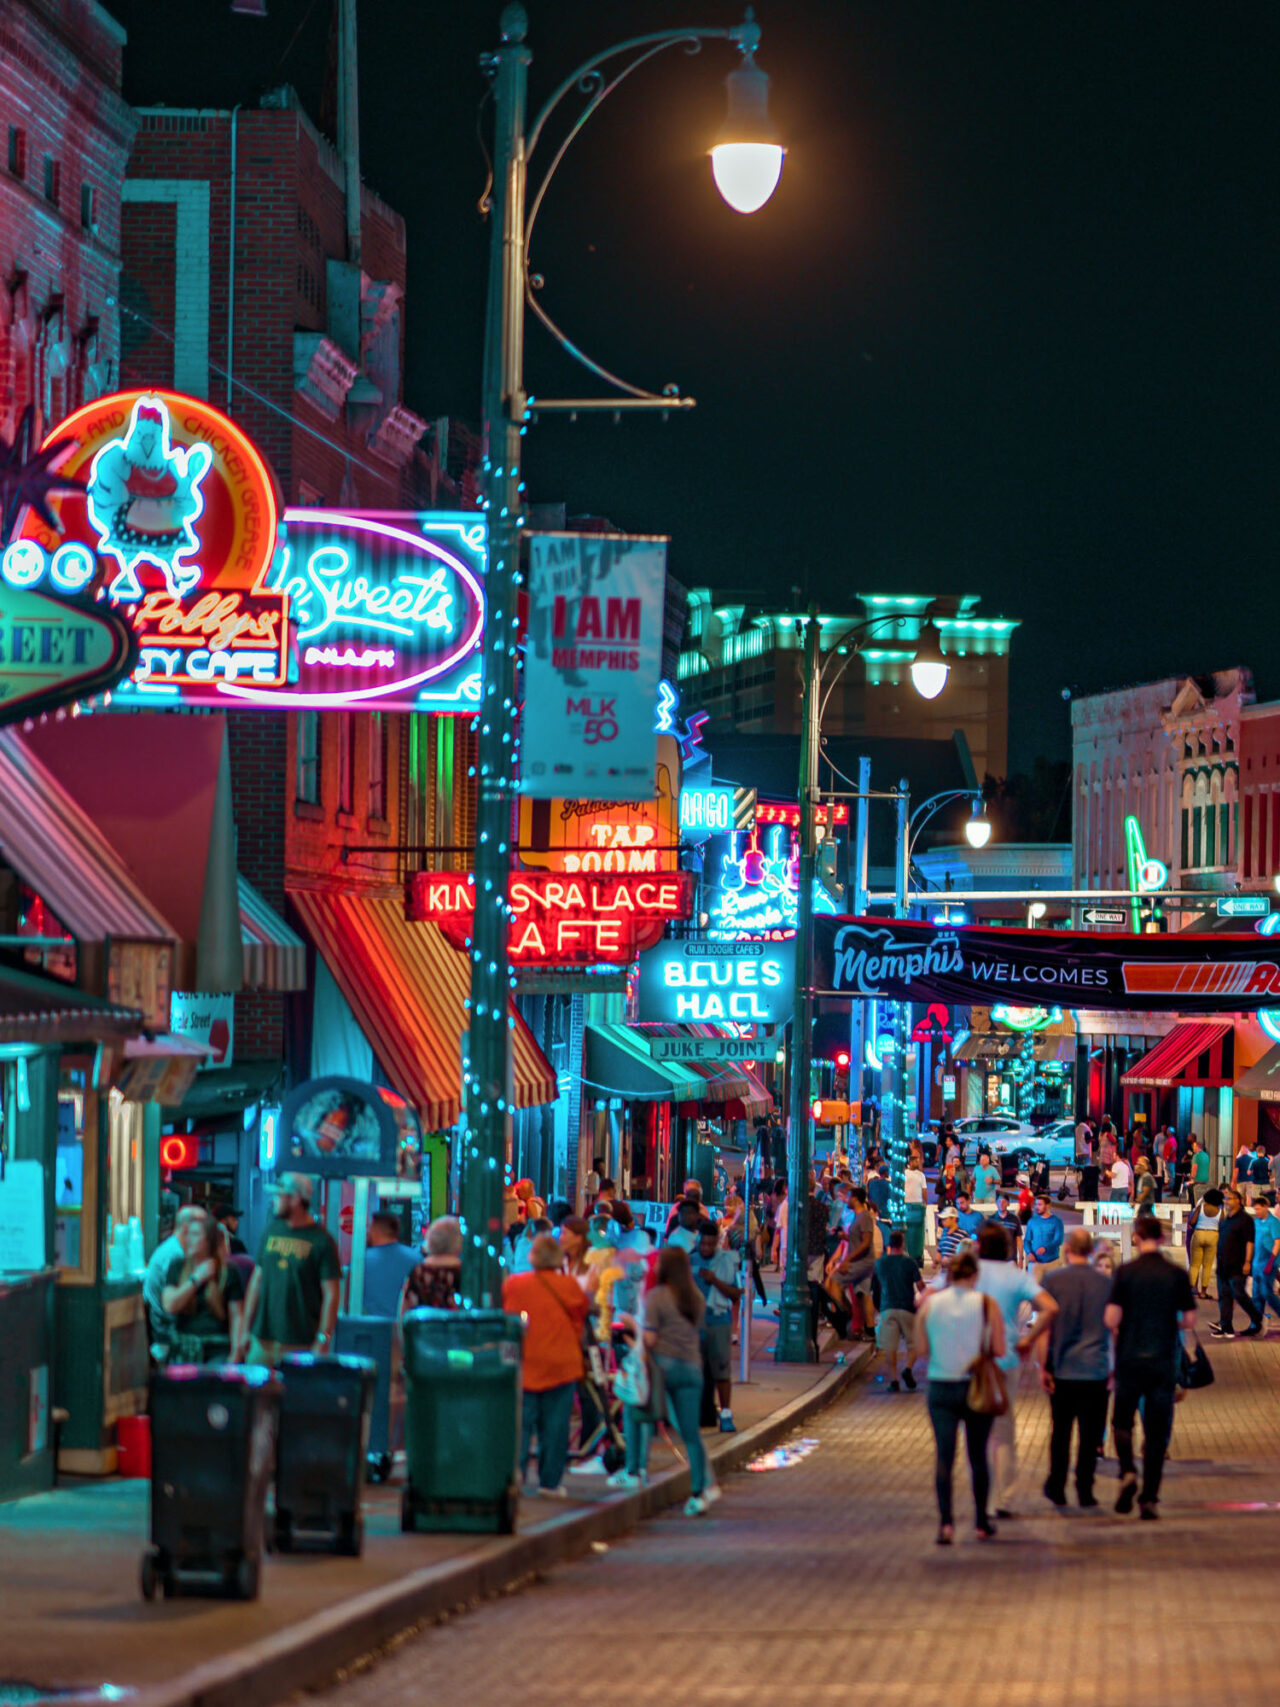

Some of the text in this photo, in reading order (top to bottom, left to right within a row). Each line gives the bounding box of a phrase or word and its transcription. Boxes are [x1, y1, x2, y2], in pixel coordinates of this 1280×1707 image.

[183, 417, 248, 481] CHICKEN
[236, 488, 261, 571] GREASE
[297, 546, 453, 639] Sweets
[553, 595, 643, 641] I AM
[0, 626, 94, 663] EET
[552, 647, 640, 672] MEMPHIS
[565, 697, 617, 718] MLK
[582, 718, 619, 745] 50
[591, 824, 656, 848] TAP
[545, 883, 679, 911] PALACE
[1231, 902, 1265, 911] ONE WAY
[1095, 912, 1122, 921] ONE WAY
[508, 919, 622, 956] AFE
[688, 944, 705, 954] RUM
[707, 944, 734, 955] BOOGIE
[663, 960, 782, 987] BLUES
[833, 943, 965, 993] Memphis
[970, 961, 1109, 986] WELCOMES
[676, 992, 769, 1019] HALL
[660, 1041, 769, 1057] JUKE JOINT
